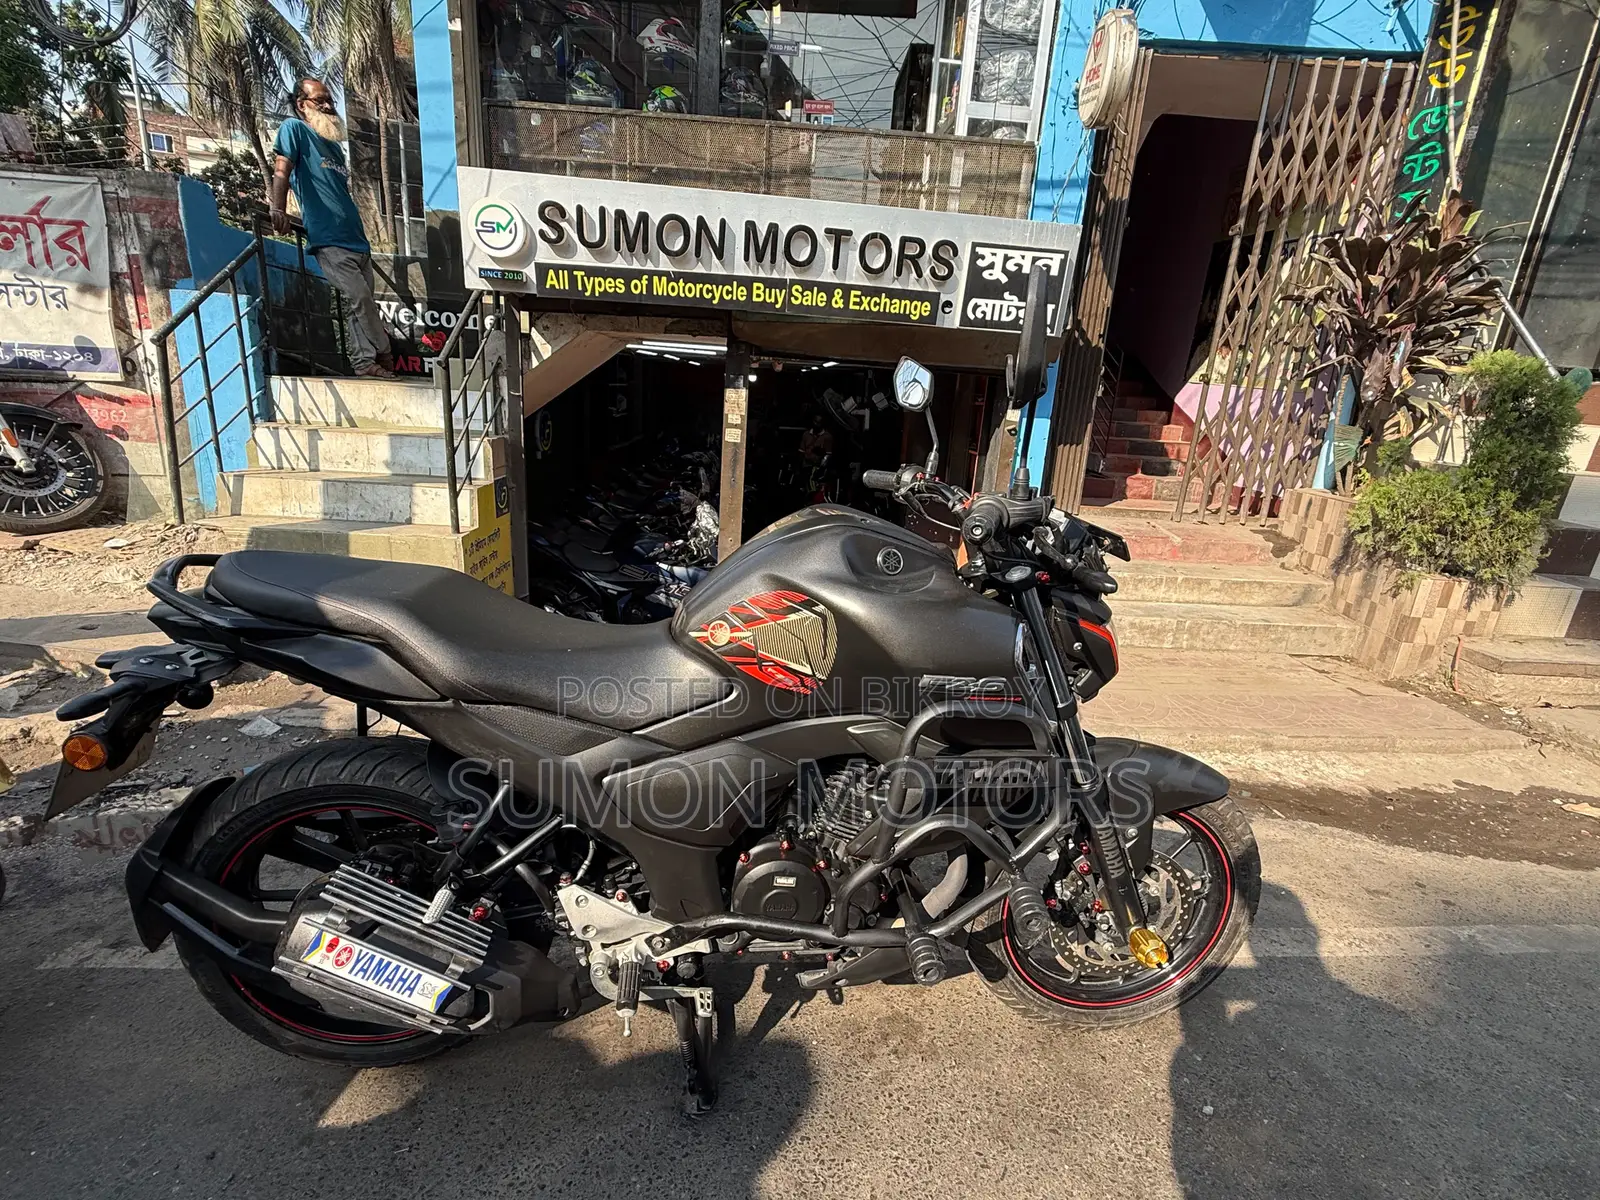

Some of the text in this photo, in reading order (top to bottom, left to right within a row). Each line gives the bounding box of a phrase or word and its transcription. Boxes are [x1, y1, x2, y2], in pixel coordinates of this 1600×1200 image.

[538, 200, 959, 282] SUMON MOTORS
[976, 246, 1065, 284] সুমন
[480, 270, 523, 280] SINCE 2010
[545, 269, 931, 320] All Types of Motorcycle Buy Sale & Exchange
[348, 949, 422, 998] YAMAHA
